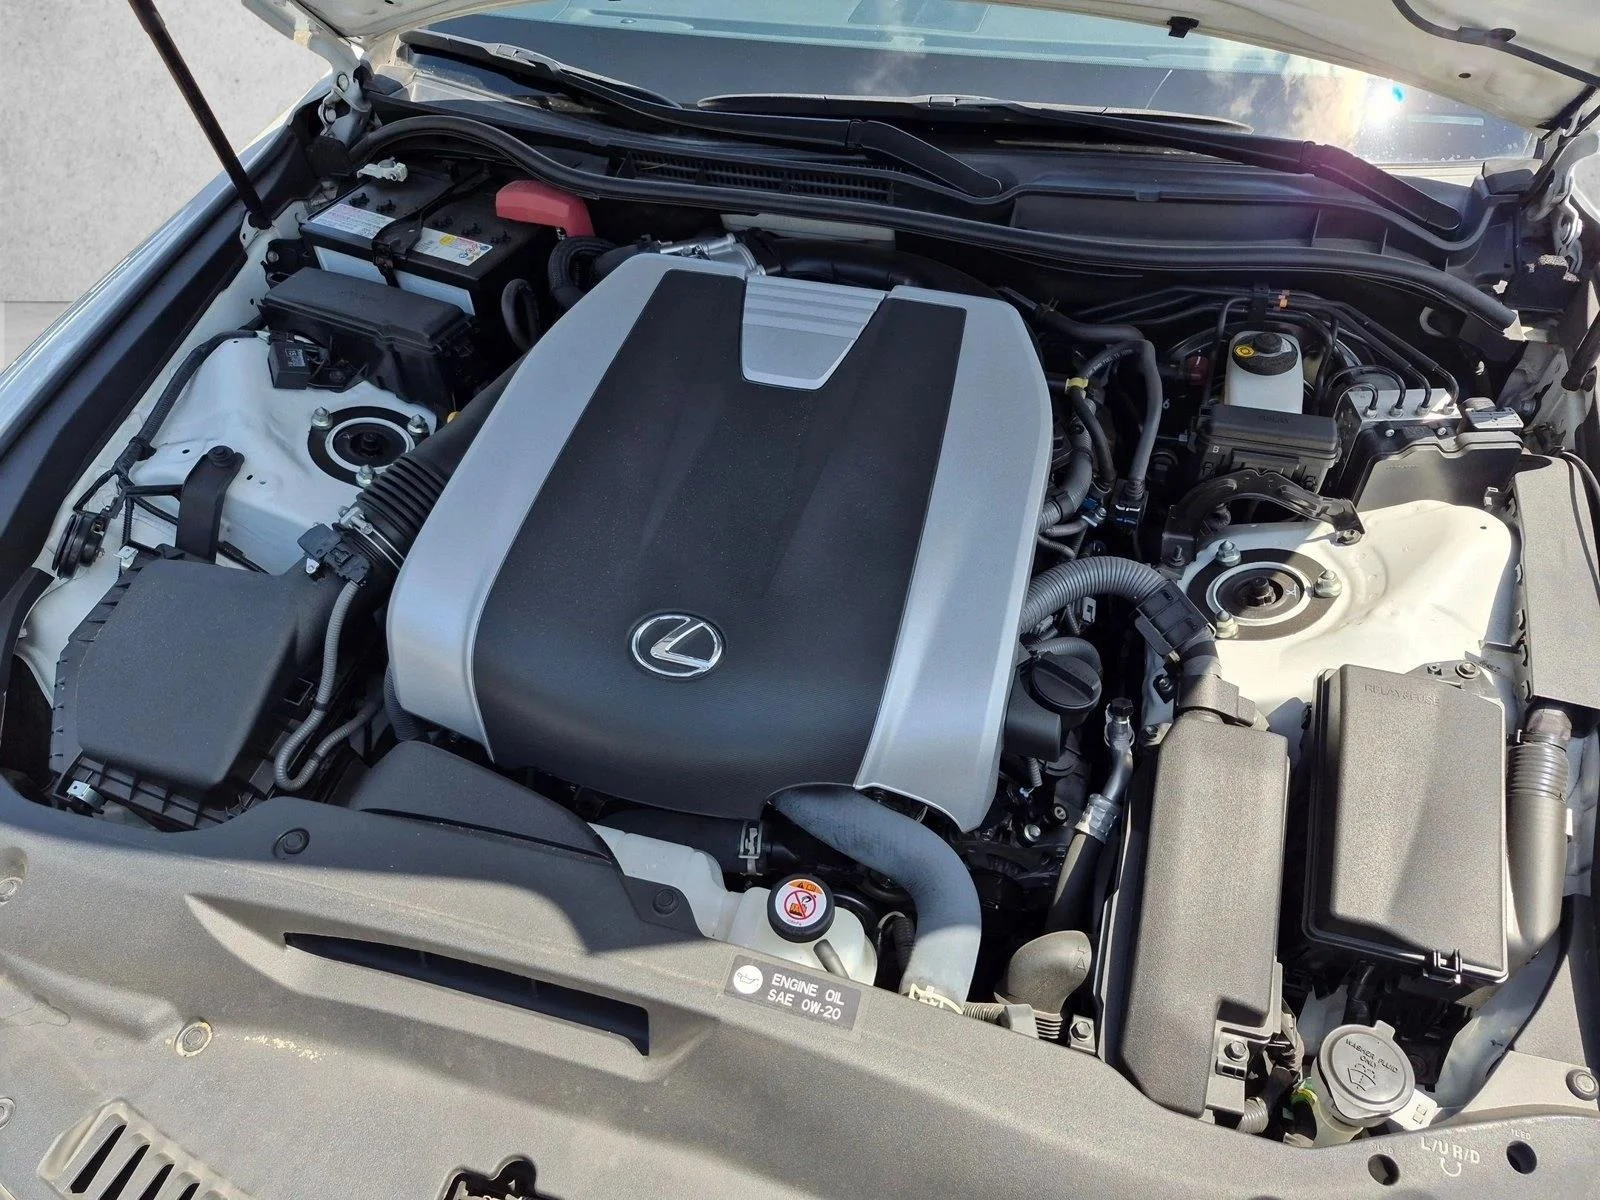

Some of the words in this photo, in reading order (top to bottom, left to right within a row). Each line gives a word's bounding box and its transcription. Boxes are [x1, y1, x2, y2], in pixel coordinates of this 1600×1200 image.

[767, 988, 794, 1007] SAE
[801, 999, 842, 1020] 0W-20
[771, 973, 818, 997] ENGINE
[825, 989, 845, 1006] OIL
[1345, 1038, 1375, 1060] WASHER
